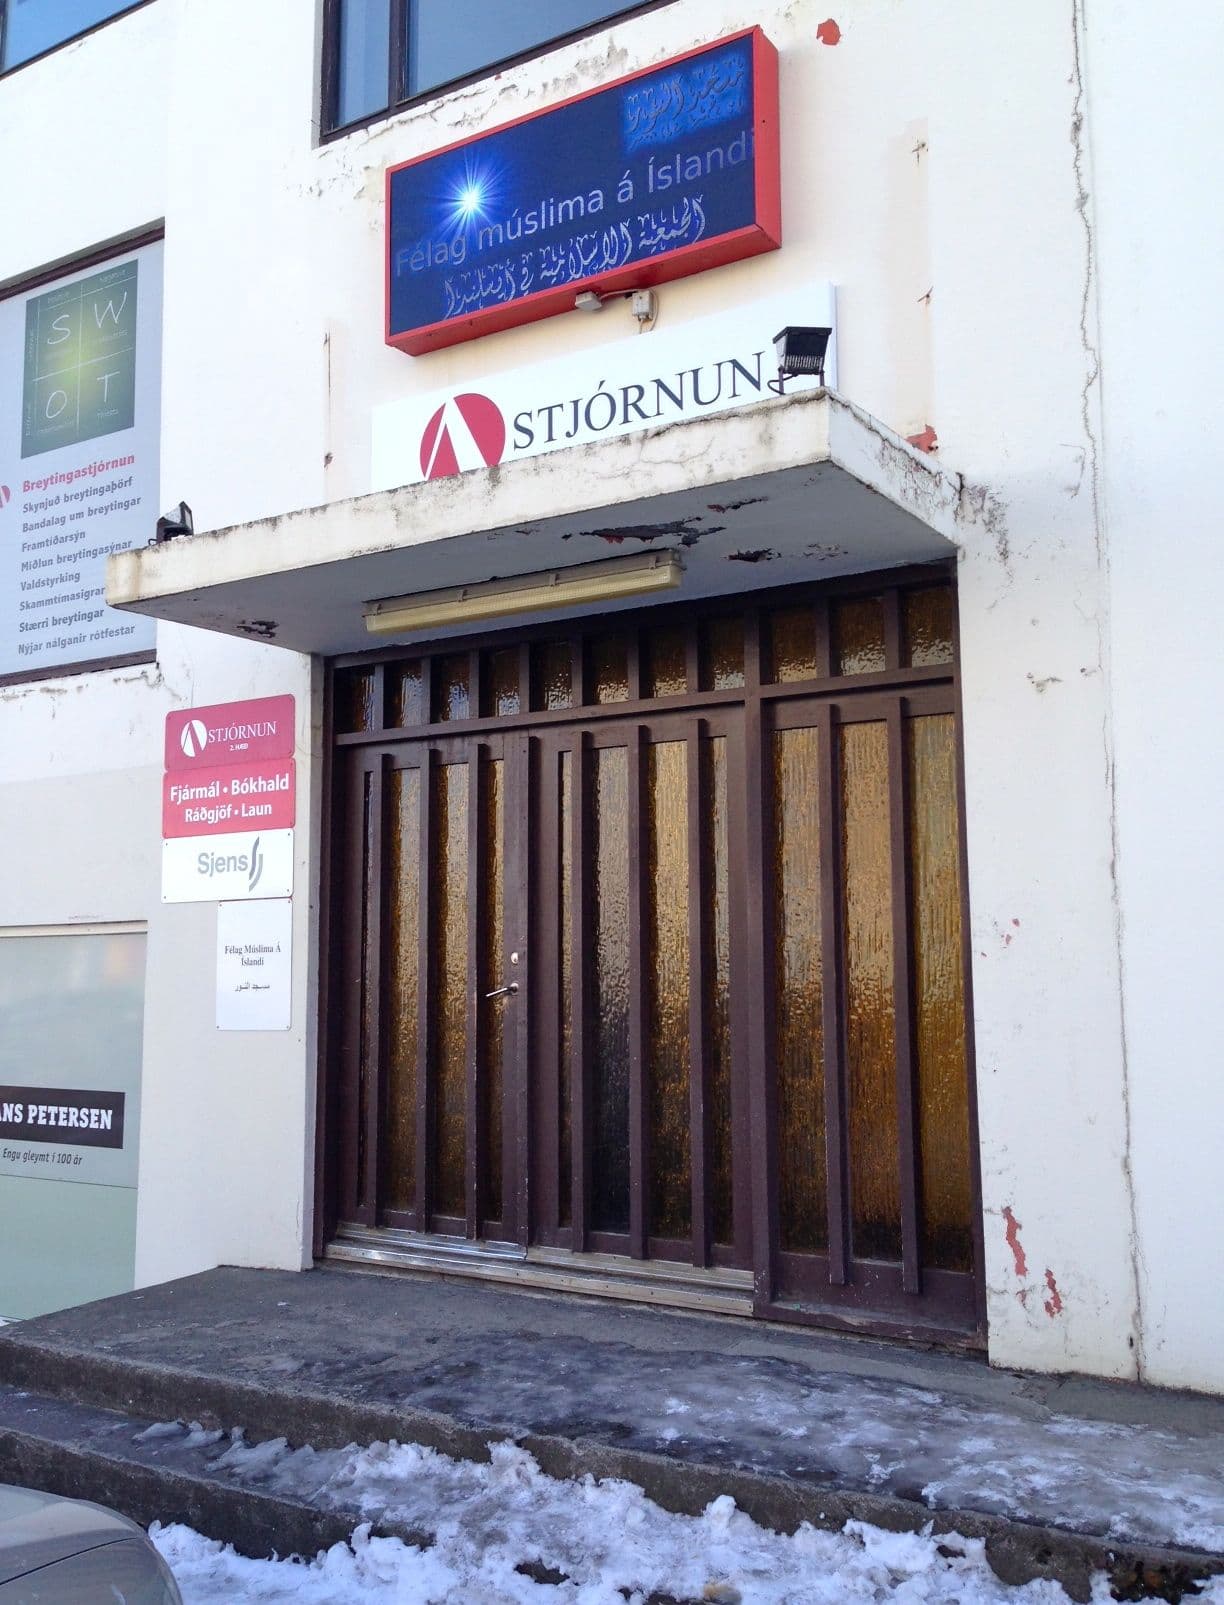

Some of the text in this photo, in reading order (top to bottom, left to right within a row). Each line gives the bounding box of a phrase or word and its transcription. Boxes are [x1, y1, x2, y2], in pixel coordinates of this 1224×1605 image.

[396, 236, 466, 277] Félag
[478, 189, 604, 250] múslima
[617, 169, 634, 204] á
[47, 291, 127, 345] S W
[513, 351, 766, 450] STJÓRNUN
[22, 455, 135, 493] Breytingastjórnun
[22, 476, 133, 514] Skynjuð breytingaþörf
[22, 497, 141, 533] Bandalag um breytingar
[21, 558, 54, 572] Miðlun
[20, 571, 81, 591] Valdstyrking
[19, 609, 104, 633] Stærri breytingar
[208, 721, 277, 743] STJÓRNUN
[170, 773, 289, 805] Fjármál Bókhald
[185, 803, 272, 824] Ráðgjöf Laun
[197, 852, 249, 878] Sjens
[27, 1104, 113, 1130] PETERSEN
[23, 1150, 50, 1164] gleymt
[57, 1153, 72, 1165] 100
